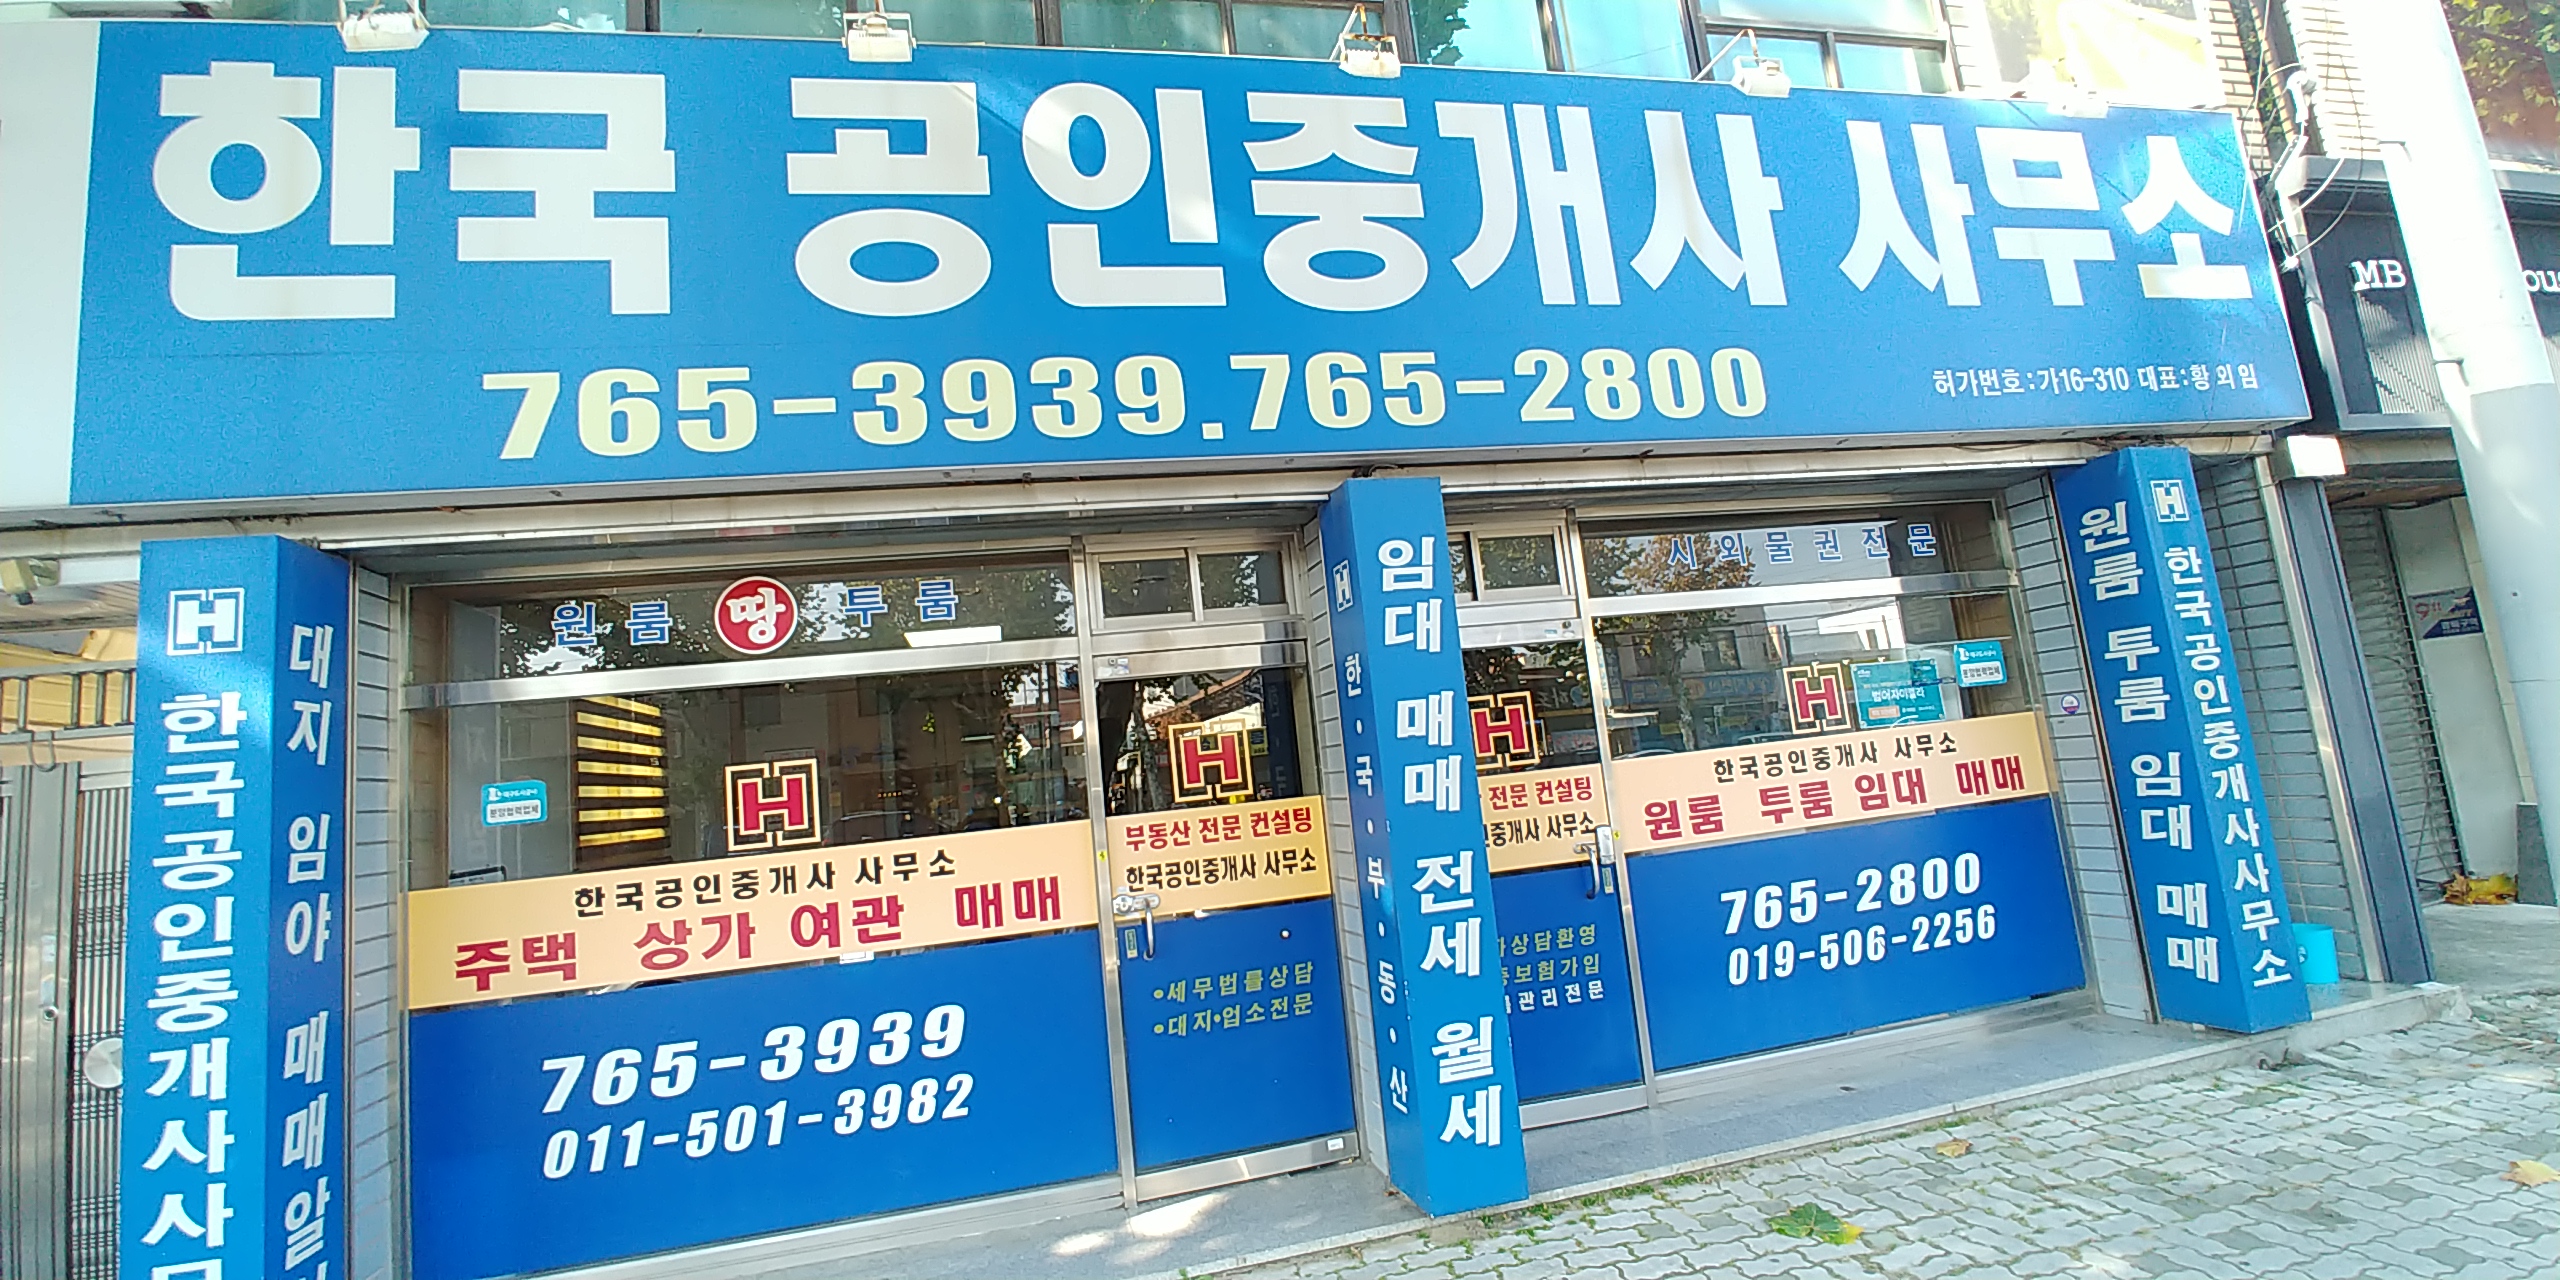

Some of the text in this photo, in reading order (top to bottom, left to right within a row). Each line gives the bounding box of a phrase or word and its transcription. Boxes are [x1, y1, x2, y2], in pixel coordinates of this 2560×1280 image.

[153, 61, 2252, 320] 한국 공인중개사 사무소
[2350, 259, 2407, 292] MB
[287, 623, 335, 767] 대지
[1713, 731, 1958, 783] 한국공인중개사 사무소
[2079, 500, 2220, 983] 원룸 투룸 임대 매매
[1125, 805, 1313, 852] 부동산 전문 컨설팅
[1488, 775, 1594, 811] 전문 컨설팅
[1643, 755, 2026, 842] 원룸 투룸 임대 매매
[574, 847, 958, 918] 한국공인중개사 사무소
[1125, 846, 1317, 893] 한국공인중개사 사무소
[1377, 536, 1502, 1146] 임대 매매 전세 월세
[285, 813, 333, 964] 임야
[1720, 852, 1981, 935] 765-2800
[455, 875, 1062, 993] 주택 상가 여관 매매
[1728, 904, 1996, 986] 019-506-2256
[539, 1003, 967, 1115] 765-3939
[542, 1072, 975, 1180] 011-501-3982
